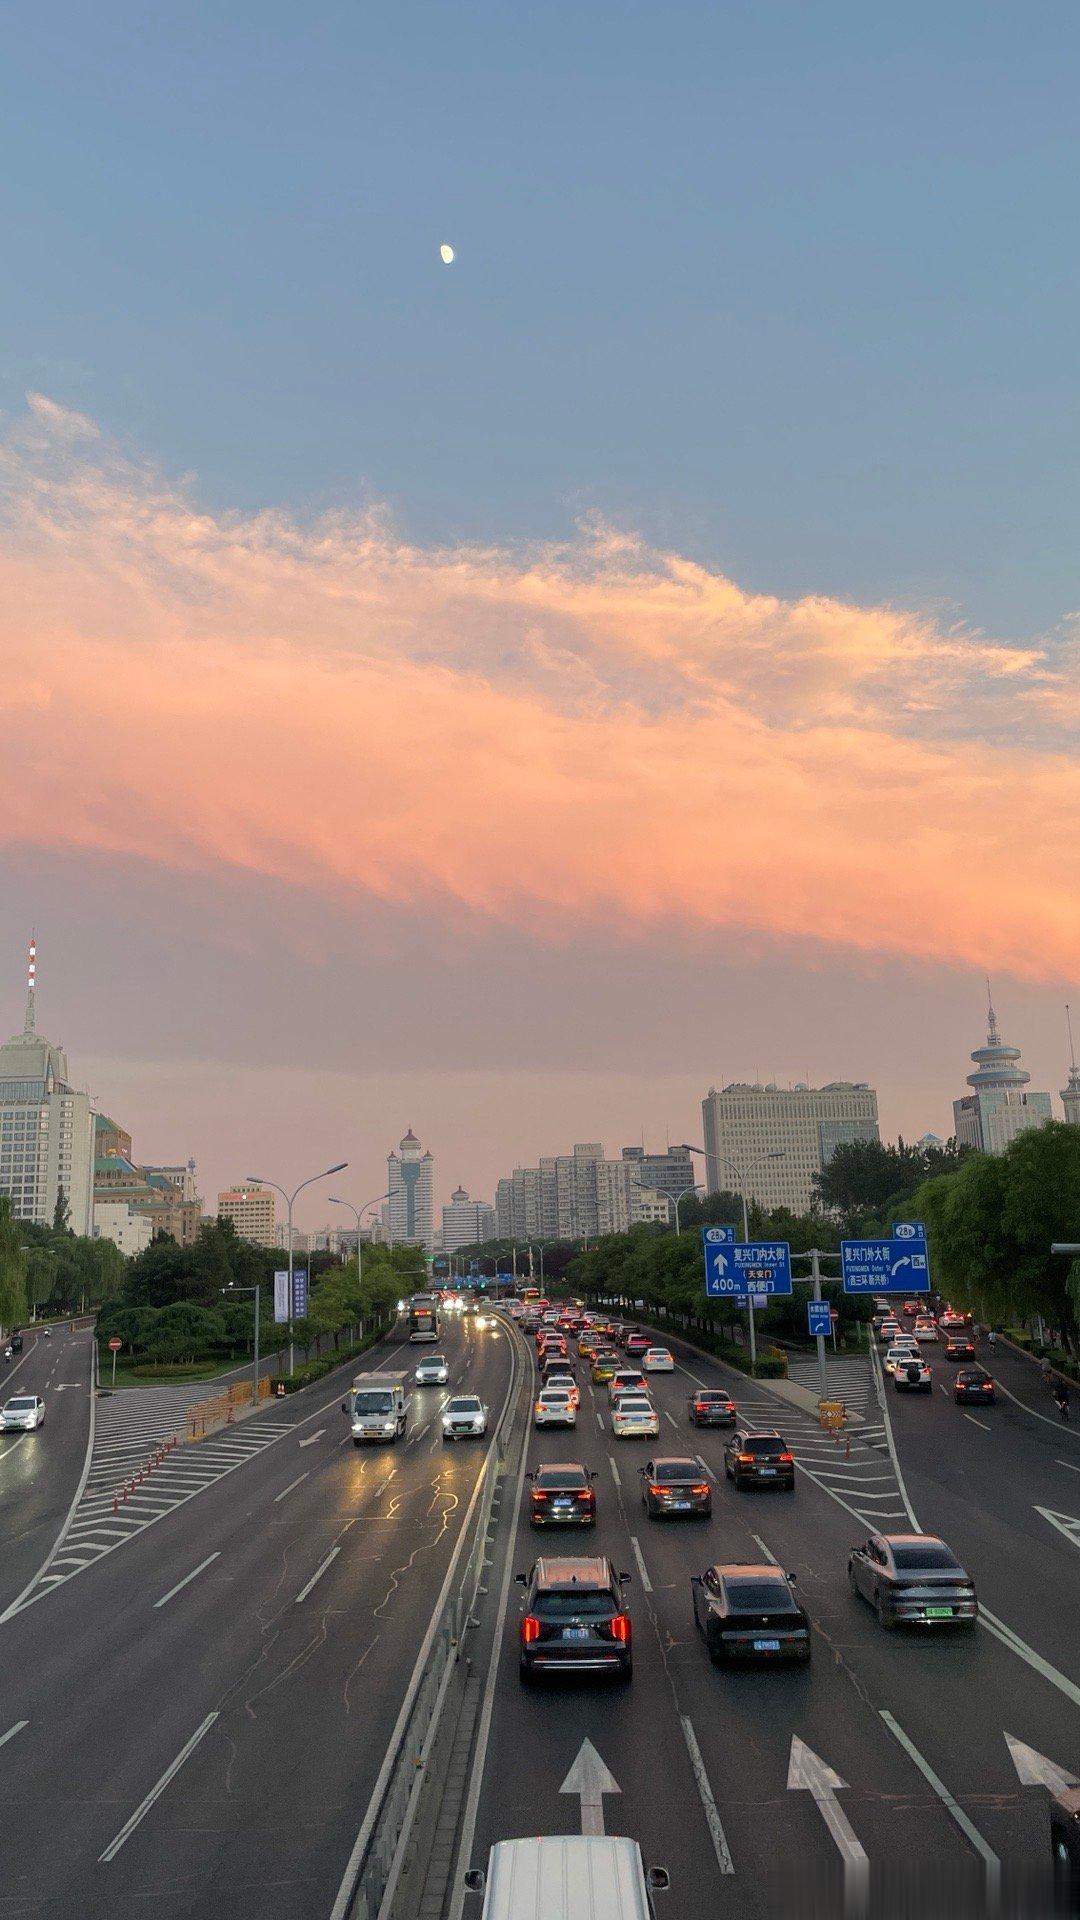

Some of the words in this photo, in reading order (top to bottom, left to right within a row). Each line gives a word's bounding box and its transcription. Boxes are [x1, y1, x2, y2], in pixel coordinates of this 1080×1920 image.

[734, 1248, 785, 1261] 复兴门内大街
[844, 1247, 890, 1262] 复兴门外大街
[712, 1279, 740, 1291] 400m
[747, 1281, 775, 1292] 西便门
